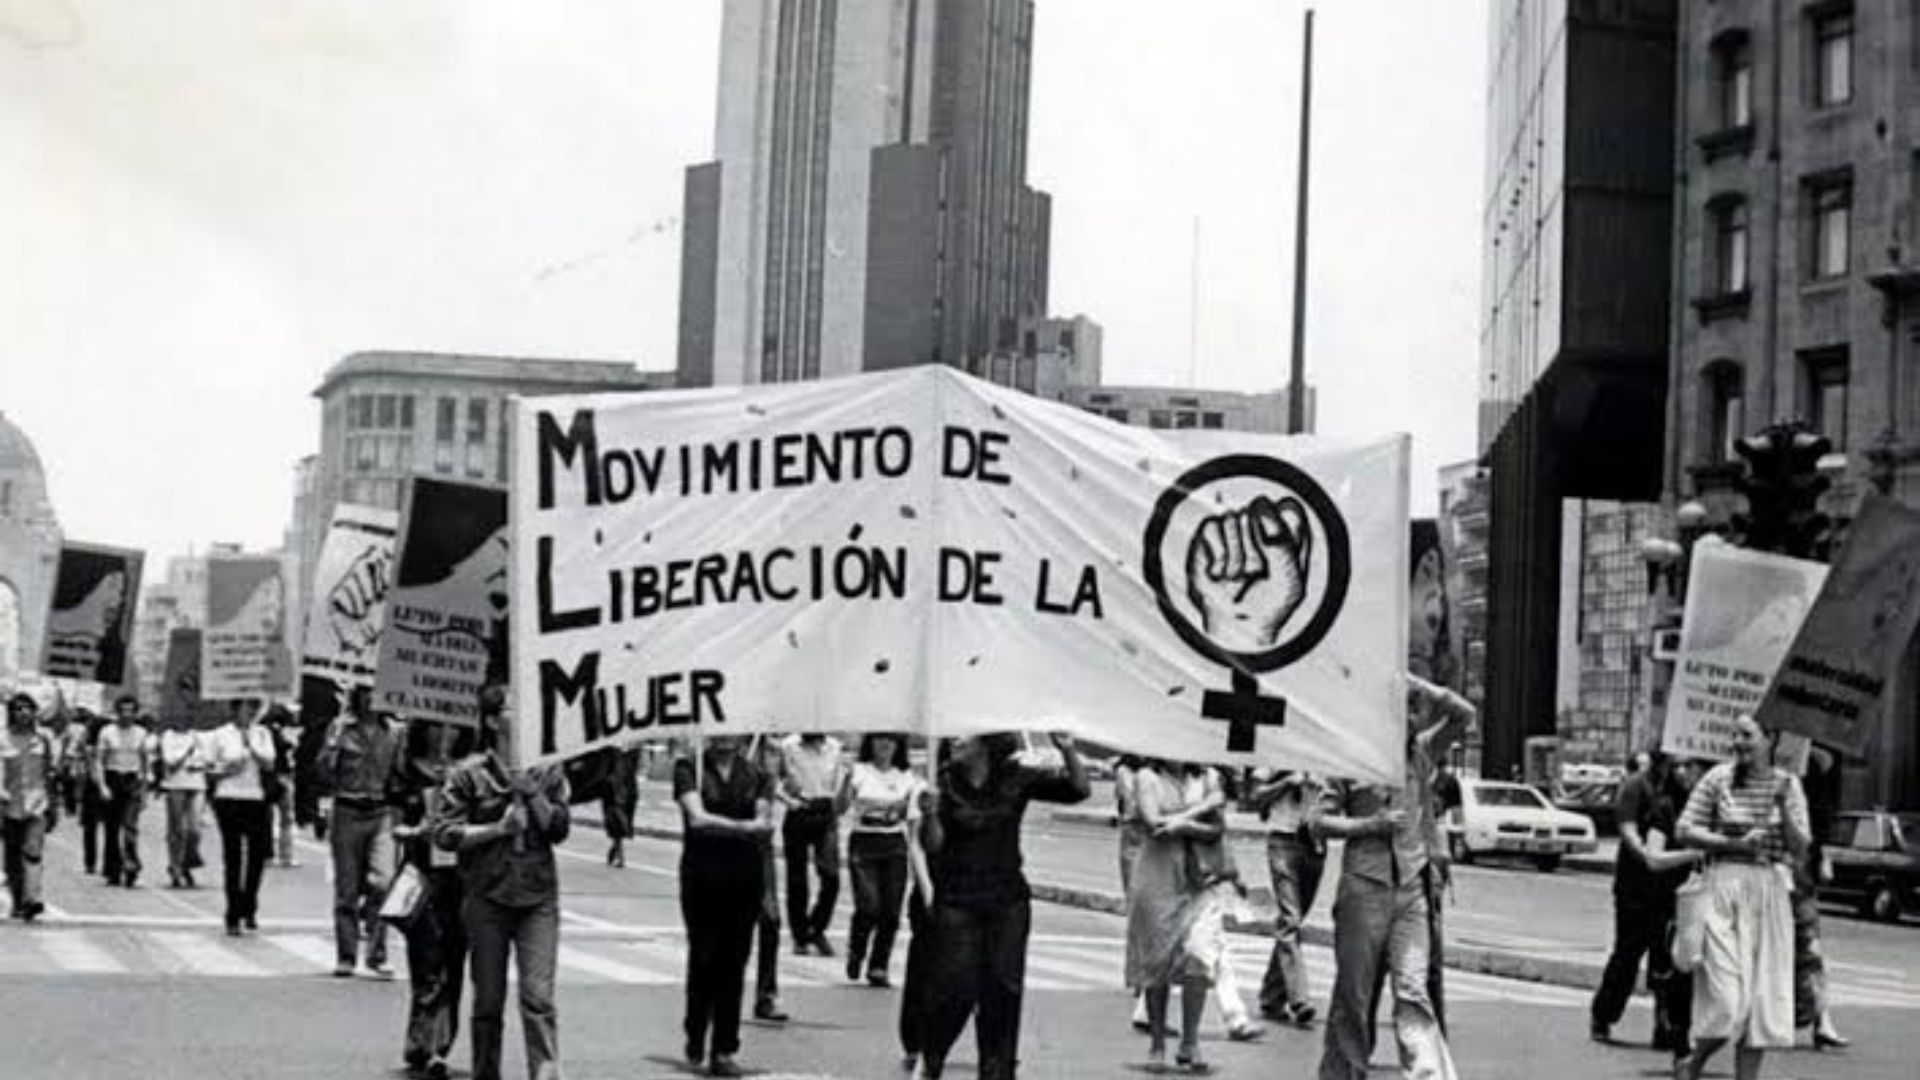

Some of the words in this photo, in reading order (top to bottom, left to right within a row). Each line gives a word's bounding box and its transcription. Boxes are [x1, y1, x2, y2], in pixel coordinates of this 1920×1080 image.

[537, 409, 912, 510] MOVIMIENTO
[942, 425, 1011, 485] DE
[537, 523, 908, 634] LIBERACIÓN
[938, 547, 1004, 606] DE
[1035, 558, 1104, 619] LA
[538, 651, 726, 755] MUJER
